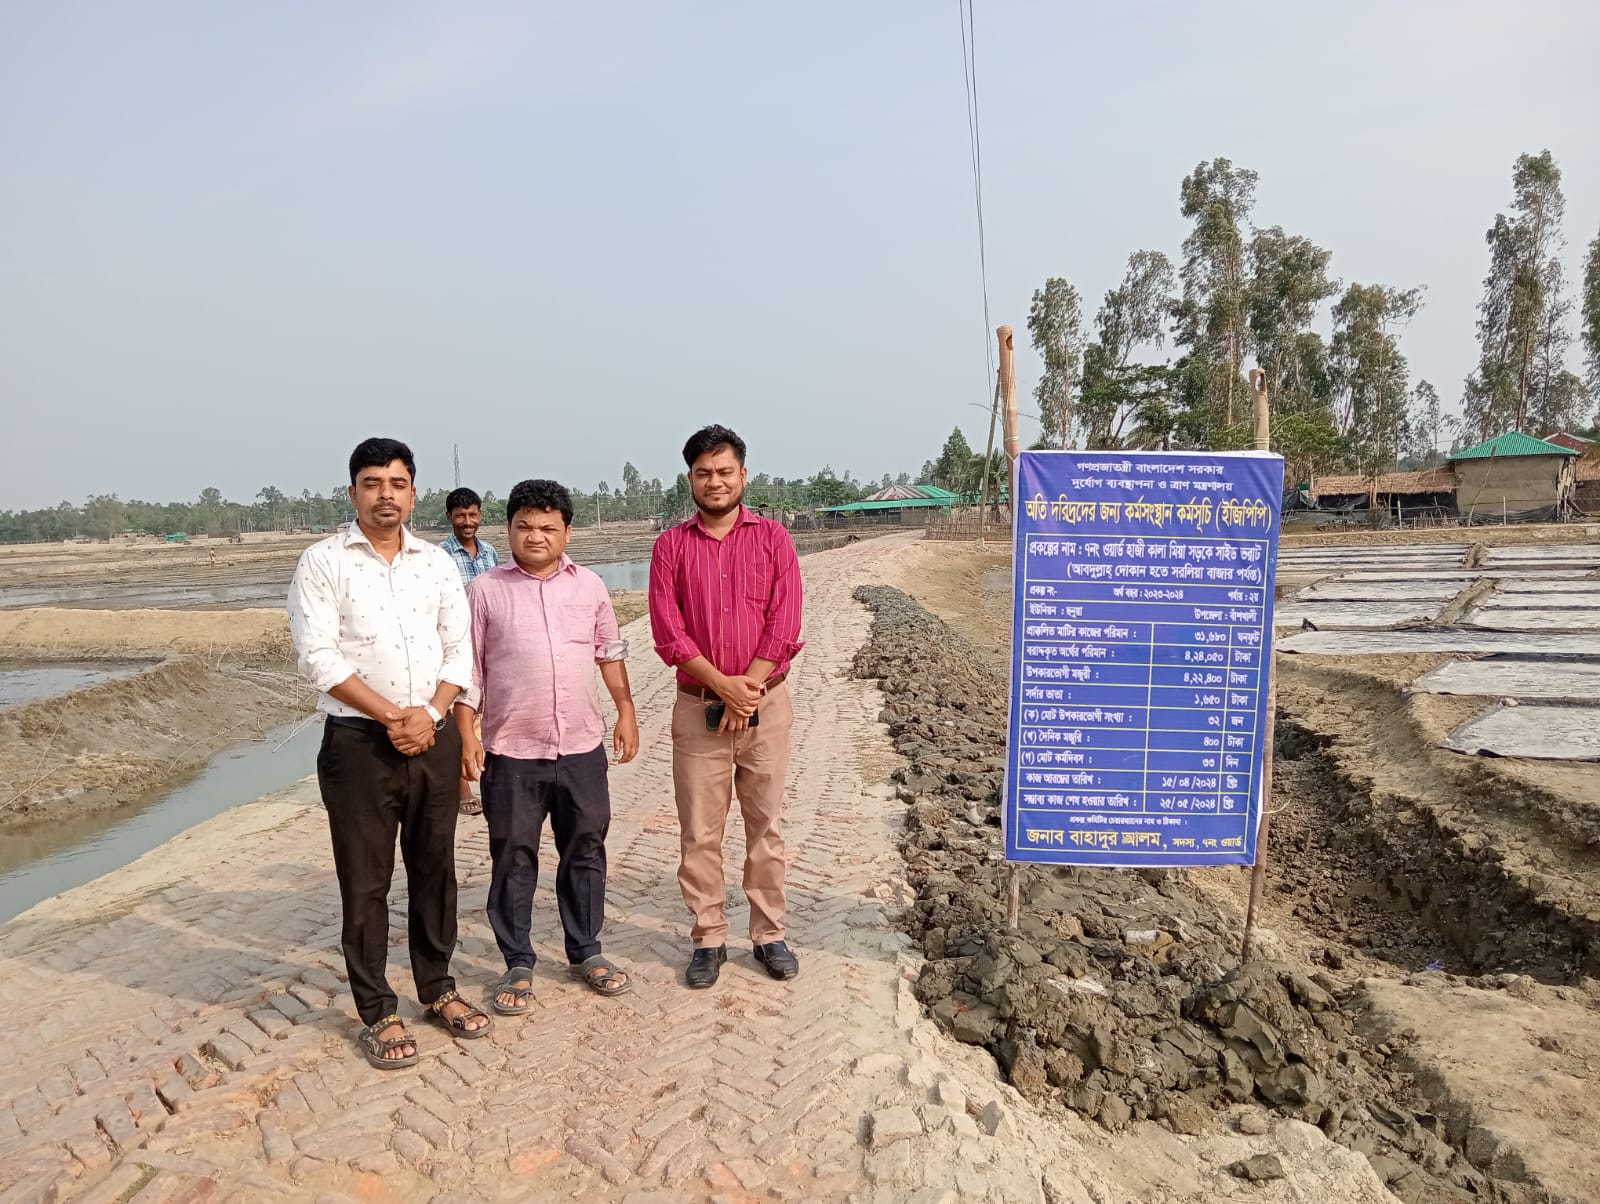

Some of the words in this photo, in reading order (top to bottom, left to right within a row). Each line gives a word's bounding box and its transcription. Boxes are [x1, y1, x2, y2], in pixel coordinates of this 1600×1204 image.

[1077, 461, 1132, 472] গণপ্রজাতন্ত্রী
[1136, 463, 1185, 473] বাংলাদেশ
[1188, 465, 1224, 474] সরকার
[1071, 476, 1103, 489] দুর্যোগ
[1106, 479, 1154, 490] ব্যবস্থাপনা
[1170, 481, 1190, 490] ত্রাণ
[1024, 492, 1048, 521] অতি
[1050, 493, 1097, 525] দরিদ্রদের
[1099, 503, 1122, 523] জন্য
[1124, 495, 1174, 529] কর্মসংস্থান
[1176, 496, 1213, 533] কর্মসূচি
[1216, 497, 1272, 534] (ইজিপিপি)
[1029, 540, 1059, 556] প্রকল্পের
[1061, 541, 1076, 556] নাম
[1085, 542, 1100, 558] ৭নং
[1103, 538, 1125, 558] ওয়ার্ড
[1126, 538, 1145, 558] হাজী
[1147, 544, 1167, 559] কালা
[1169, 540, 1186, 560] মিয়া
[1188, 546, 1213, 562] সড়কে
[1216, 542, 1238, 561] সাইড
[1240, 544, 1262, 562] ভরাট
[1115, 564, 1146, 577] দোকান
[1149, 566, 1169, 577] হতে
[1206, 567, 1234, 580] বাজার
[1236, 565, 1262, 584] পর্যন্ত)
[1113, 585, 1125, 597] অর্থ
[1144, 589, 1184, 600] ২০২৩-২০২৪
[1029, 603, 1057, 616] ইউনিয়ন
[1194, 608, 1223, 620] উপজেলা
[1057, 624, 1076, 637] মাটির
[1078, 627, 1102, 637] কাজের
[1059, 644, 1079, 657] অর্থের
[1234, 649, 1252, 663] টাকা
[1026, 664, 1070, 679] উপকারভোগী
[1231, 671, 1248, 684] টাকা
[1045, 690, 1063, 700] ভাতা
[1194, 694, 1220, 706] ১,৬৫০
[1231, 692, 1248, 706] টাকা
[1024, 709, 1039, 722] (ক)
[1041, 708, 1057, 721] মোট
[1059, 708, 1104, 722] উপকারভোগী
[1104, 712, 1124, 723] সংখ্যা
[1208, 716, 1220, 726] ৩২
[1231, 716, 1244, 726] জন
[1039, 729, 1061, 742] দৈনিক
[1203, 737, 1219, 746] ৪০০
[1227, 735, 1245, 748] টাকা
[1037, 750, 1053, 763] মোট
[1202, 758, 1215, 767] ৩৩
[1225, 755, 1239, 768] দিন
[1025, 773, 1042, 783] কাজ
[1071, 771, 1093, 784] তারিখ
[1047, 795, 1064, 806] কাজ
[1065, 795, 1080, 806] শেষ
[1107, 794, 1130, 808] তারিখ
[1026, 829, 1065, 845] জনাব
[1069, 830, 1119, 850] বাহাদুর
